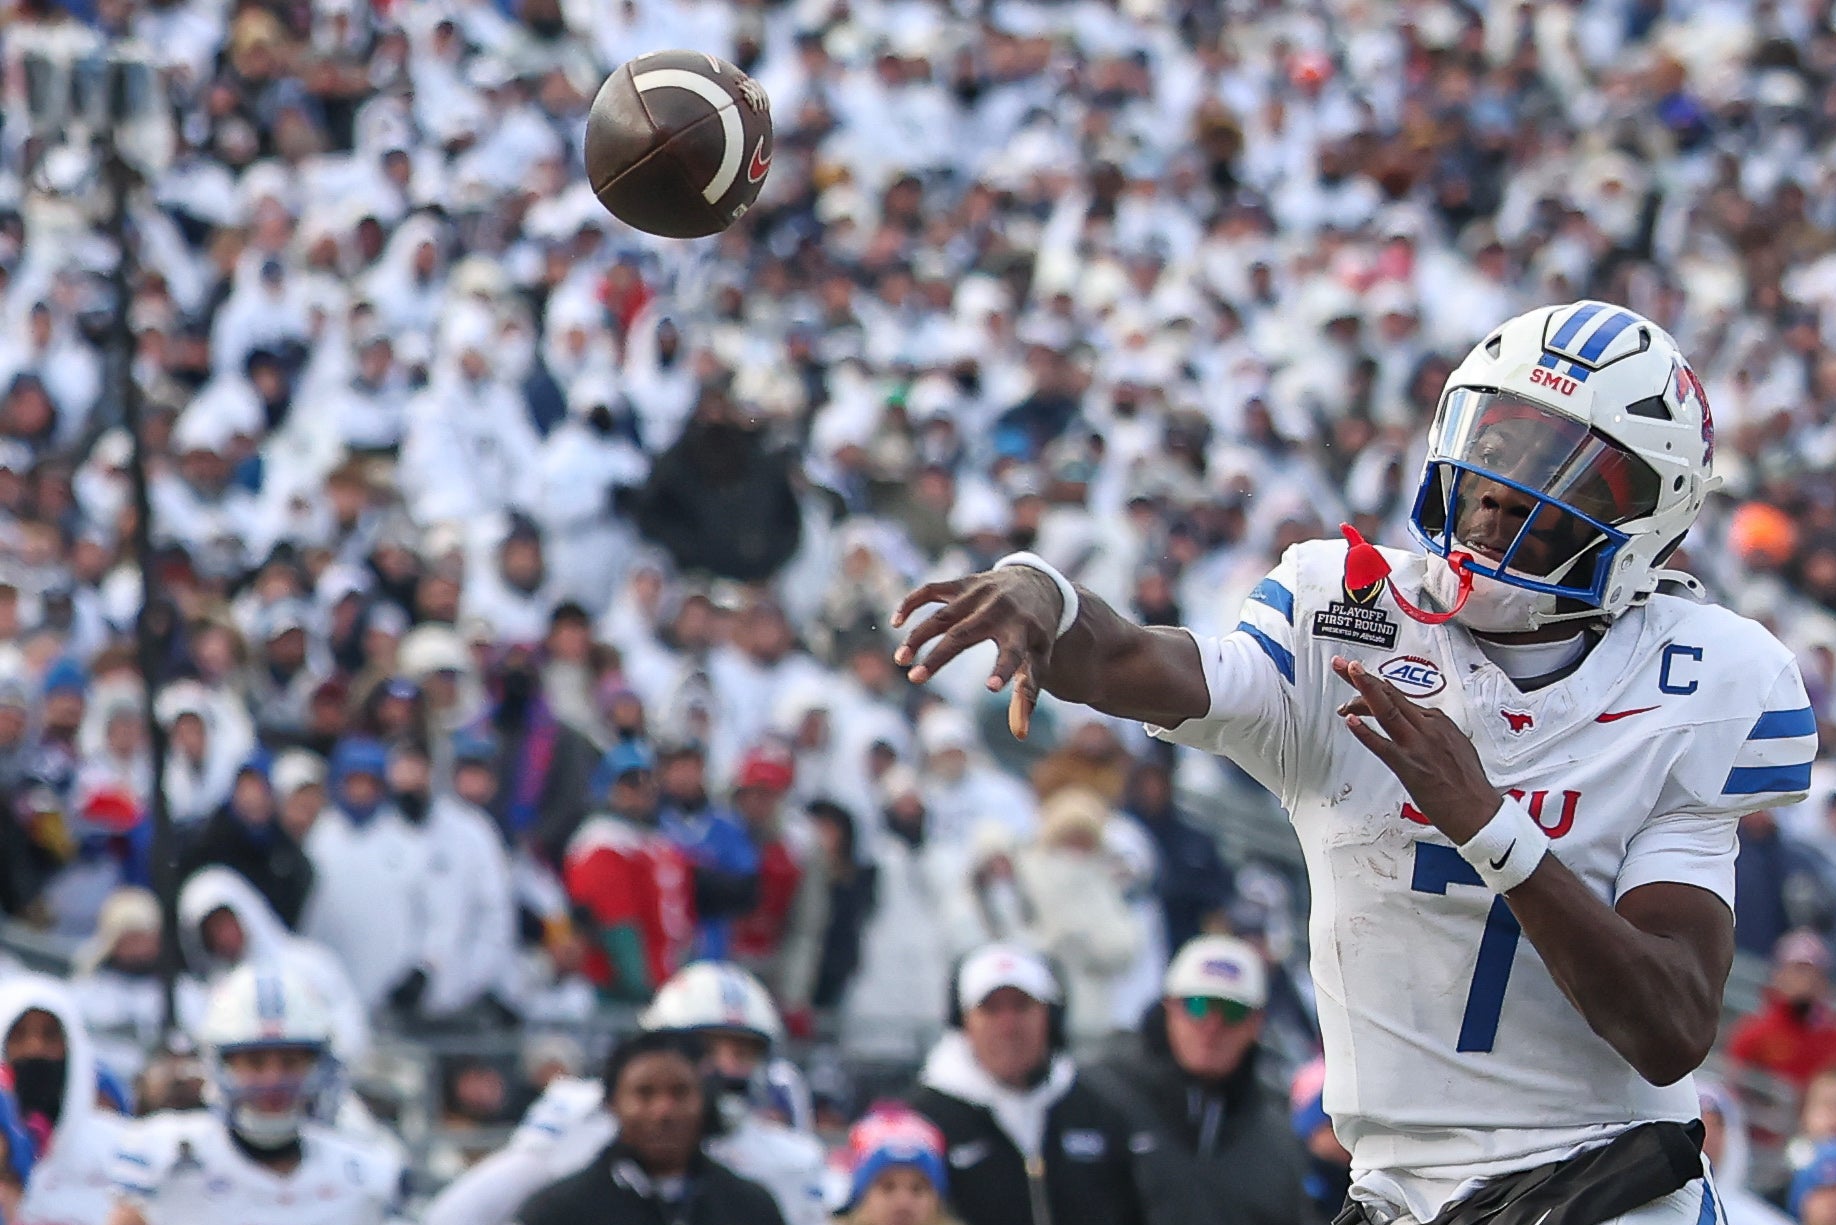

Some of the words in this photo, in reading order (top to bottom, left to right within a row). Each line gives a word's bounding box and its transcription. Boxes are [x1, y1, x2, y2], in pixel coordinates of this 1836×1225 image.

[1529, 368, 1578, 397] SMU
[1317, 613, 1353, 627] FIRST
[1354, 618, 1395, 636] ROUND
[1331, 604, 1385, 622] PLAYOFF
[1388, 664, 1439, 685] ACC
[1658, 643, 1704, 696] C
[1411, 840, 1522, 1053] 7
